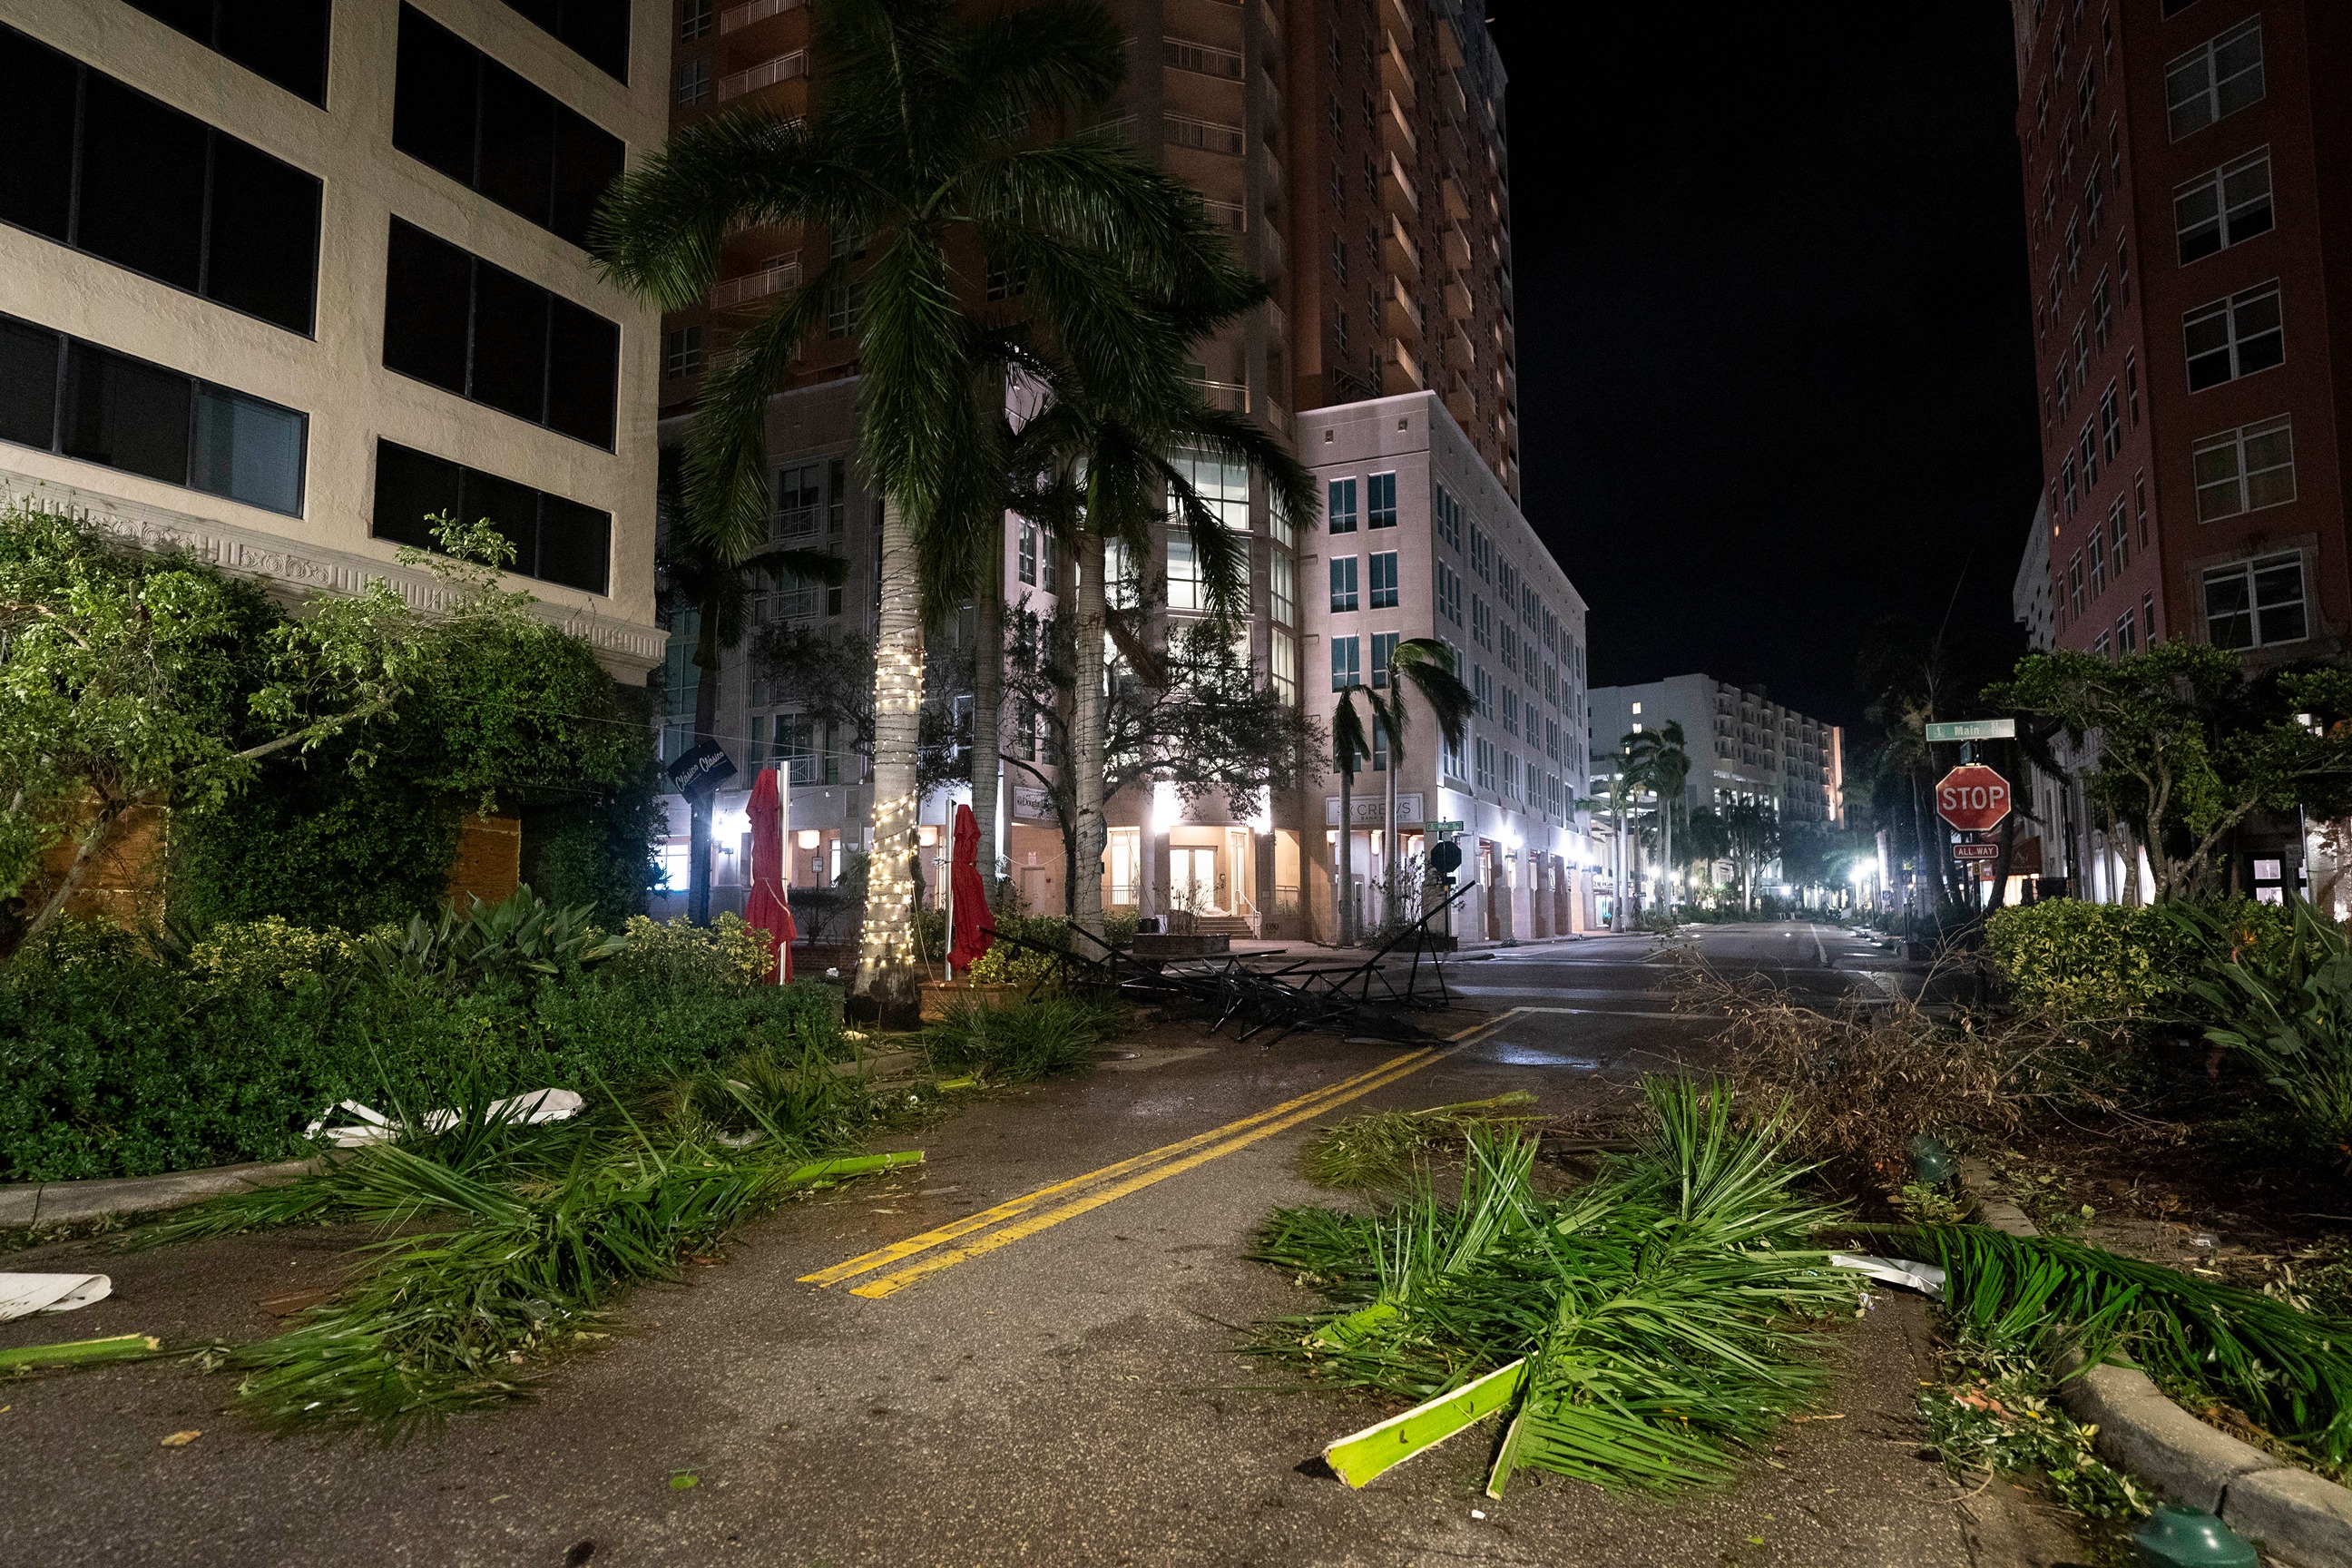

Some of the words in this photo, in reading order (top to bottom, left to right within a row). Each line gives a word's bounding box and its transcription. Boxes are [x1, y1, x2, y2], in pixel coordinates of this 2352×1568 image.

[1954, 725, 1980, 736] Main
[699, 751, 725, 772] Clásico
[675, 764, 699, 792] Clásico
[1942, 786, 2004, 810] STOP
